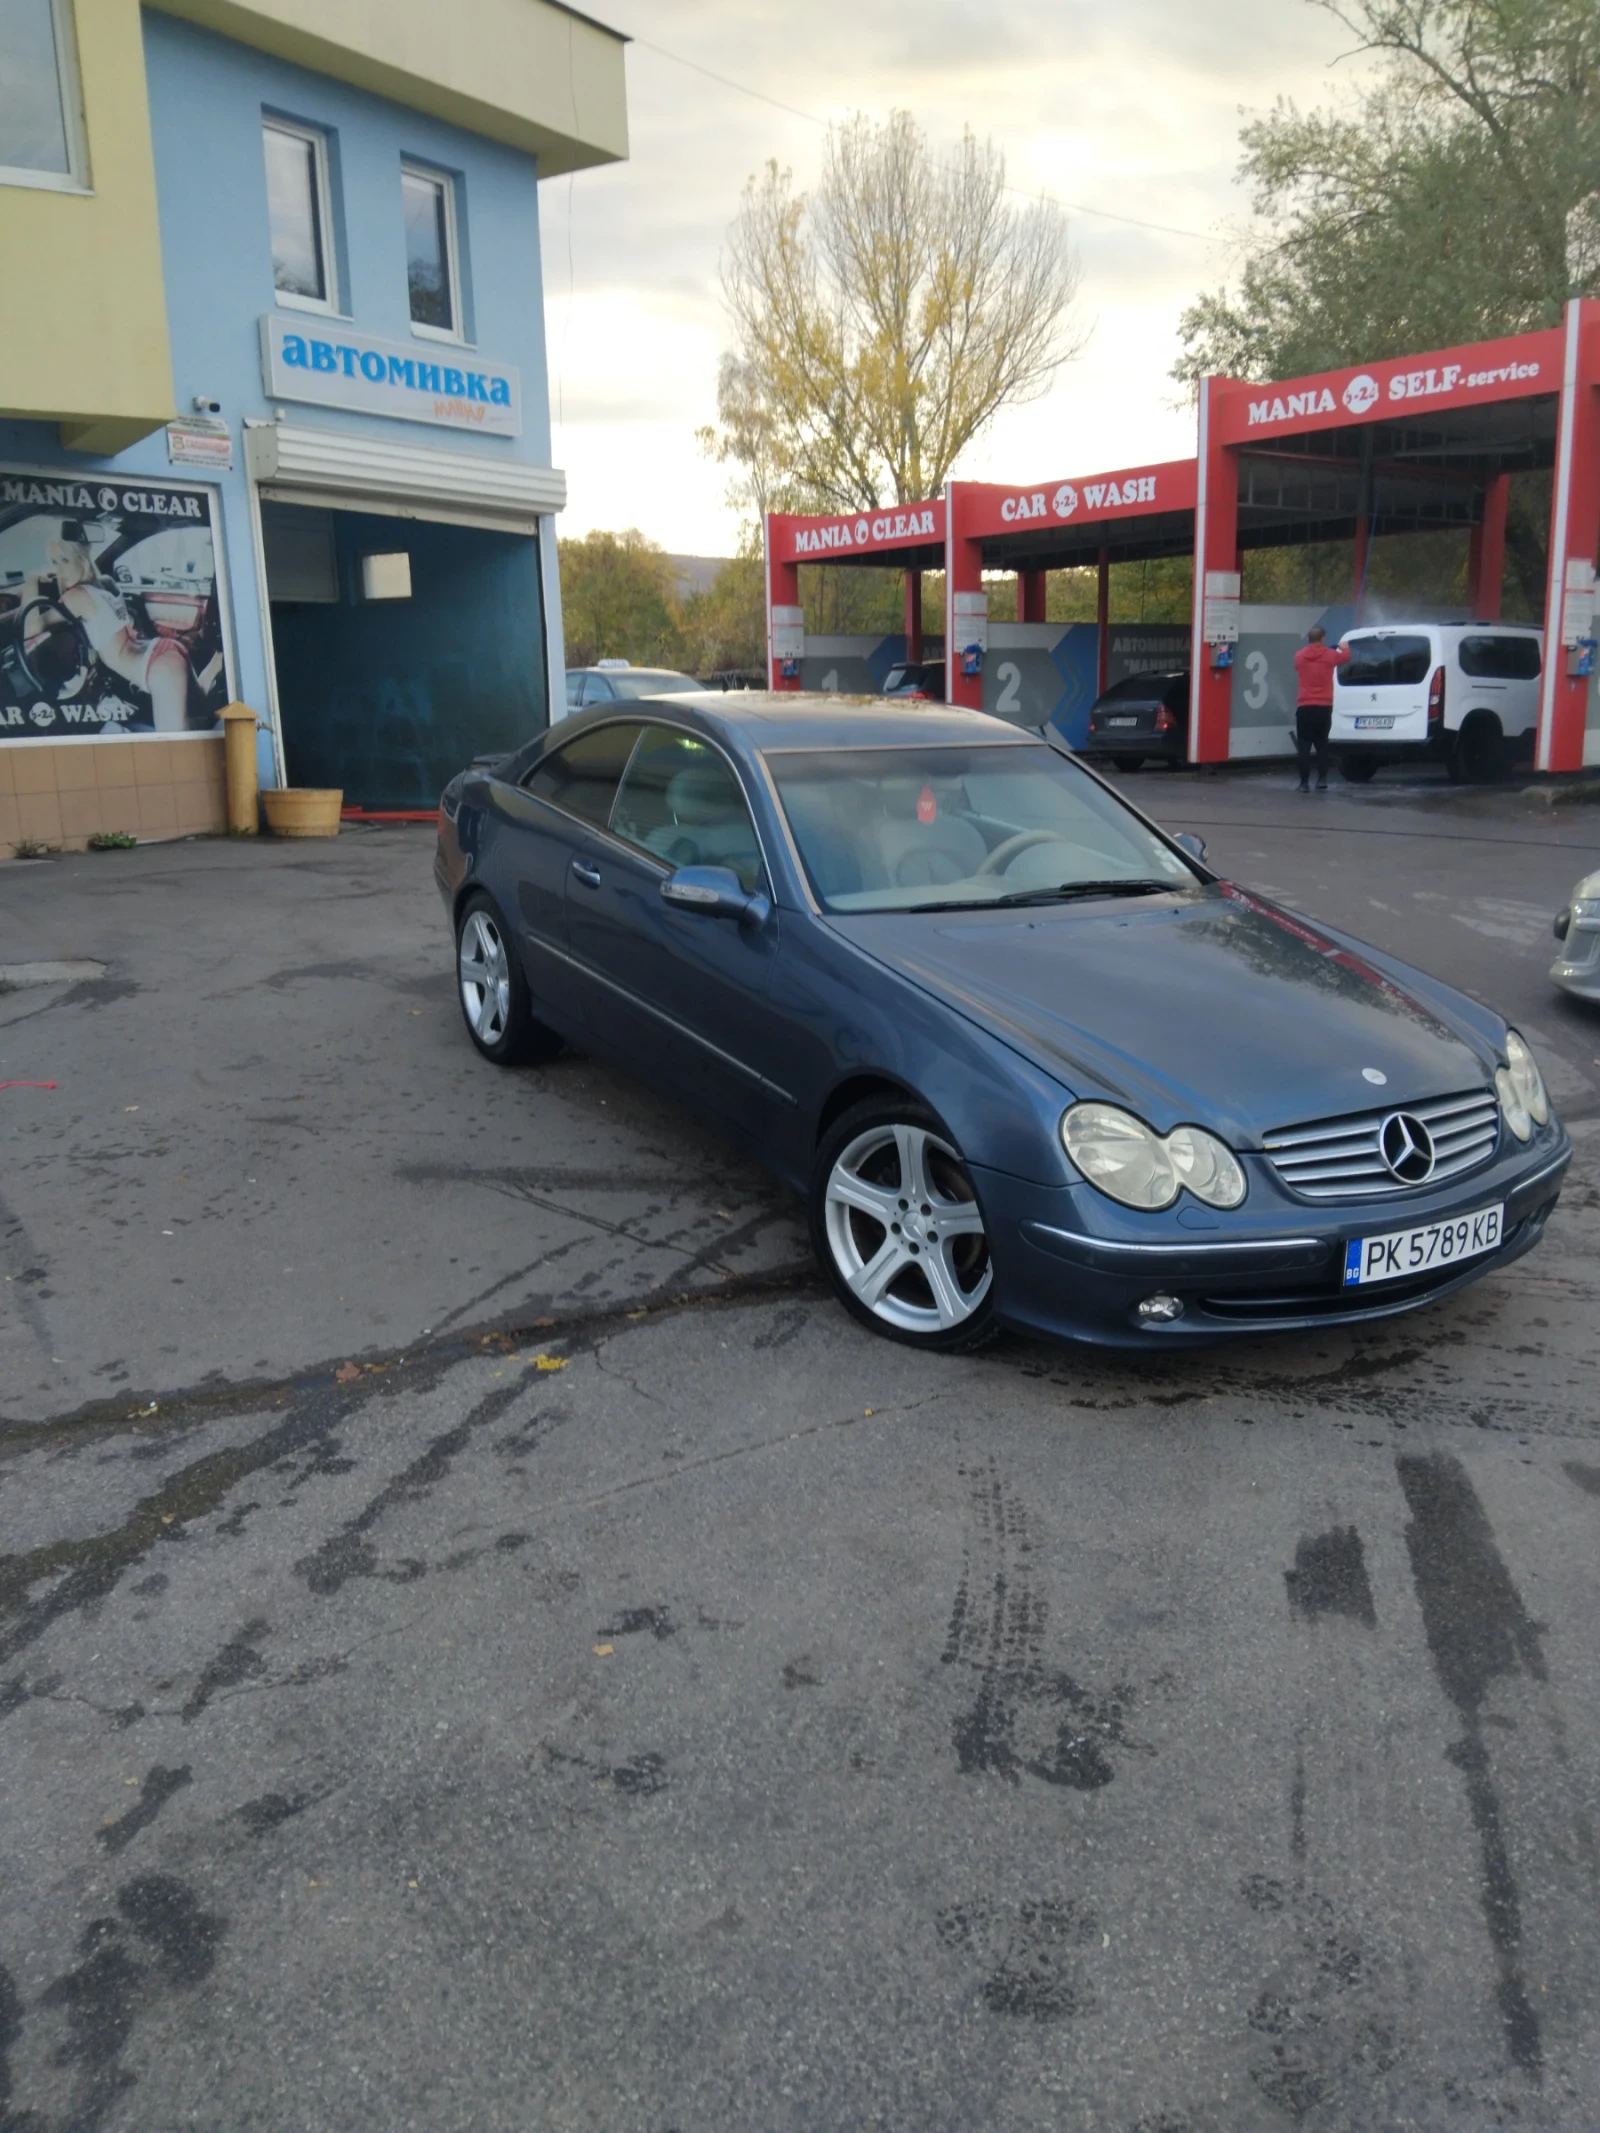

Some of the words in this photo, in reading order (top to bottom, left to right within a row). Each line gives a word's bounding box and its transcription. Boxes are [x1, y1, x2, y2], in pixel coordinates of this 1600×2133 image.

[282, 335, 511, 407] автомивка
[1248, 388, 1336, 425] MANIA
[2, 481, 96, 509] MANIA
[122, 492, 202, 517] CLEAR
[1001, 493, 1048, 522] CAR
[1083, 476, 1157, 510] WASH
[795, 524, 853, 553] MANIA
[872, 511, 936, 541] CLEAR
[996, 662, 1021, 712] 2
[1244, 651, 1268, 709] 3
[60, 705, 128, 723] WASH
[1409, 1221, 1469, 1267] 5789
[1346, 1268, 1359, 1280] BG
